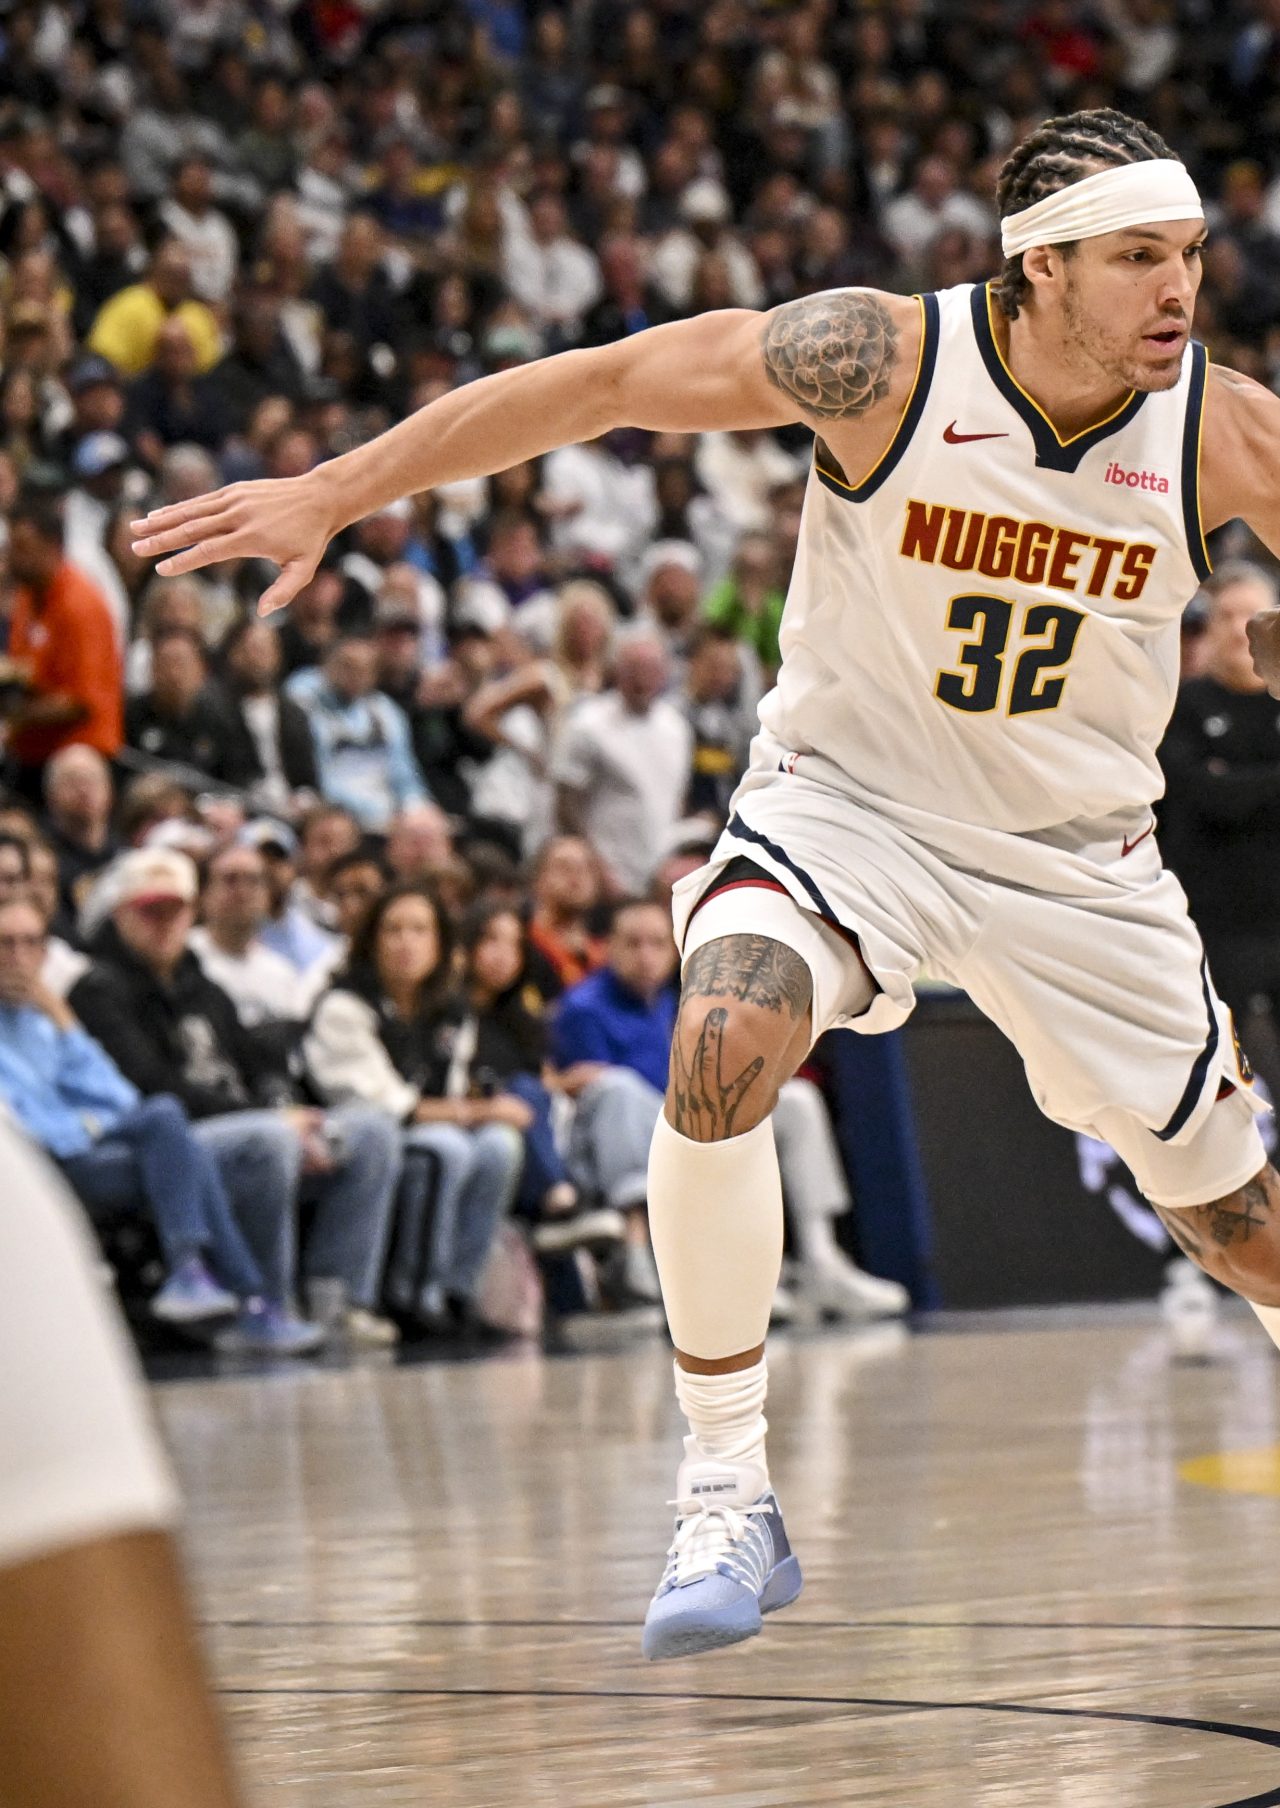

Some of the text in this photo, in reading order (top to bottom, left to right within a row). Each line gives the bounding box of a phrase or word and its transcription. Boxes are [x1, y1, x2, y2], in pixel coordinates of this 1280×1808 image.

[1104, 463, 1168, 493] ibotta
[899, 498, 1157, 600] NUGGETS
[933, 592, 1089, 719] 32
